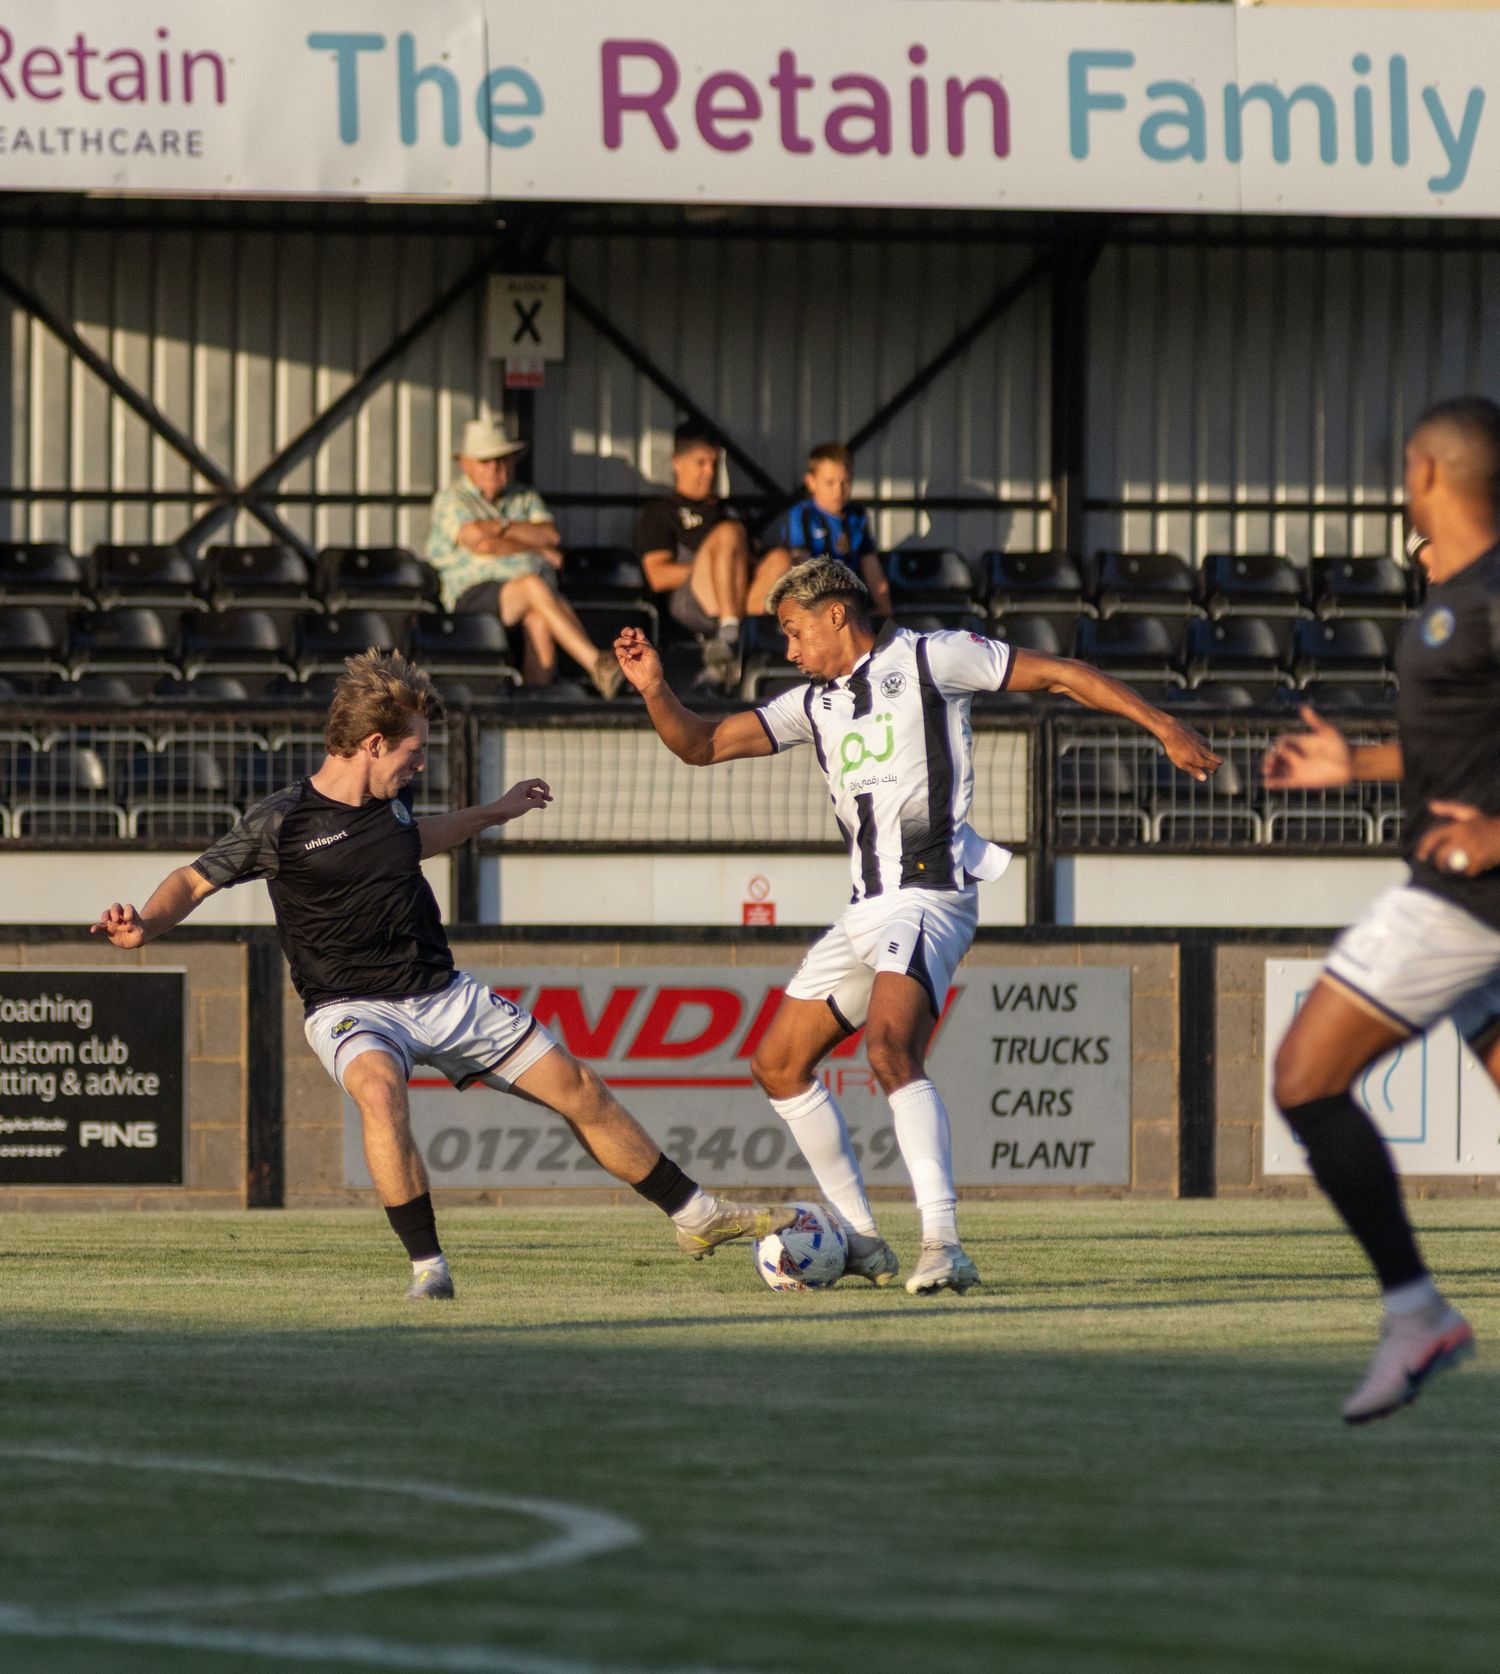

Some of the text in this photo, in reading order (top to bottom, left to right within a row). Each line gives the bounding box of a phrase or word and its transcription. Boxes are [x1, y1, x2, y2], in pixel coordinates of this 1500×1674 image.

[306, 31, 1486, 194] The Retain Family
[513, 300, 543, 344] X
[304, 830, 348, 850] uhlsport
[0, 993, 94, 1030] oaching
[991, 983, 1078, 1012] VANS
[0, 1034, 129, 1065] ustom club
[991, 1035, 1111, 1065] TRUCKS
[0, 1066, 160, 1102] tting & advice
[991, 1089, 1074, 1118] CARS
[79, 1121, 157, 1148] PING
[667, 1125, 901, 1171] 3409
[991, 1141, 1095, 1170] PLANT
